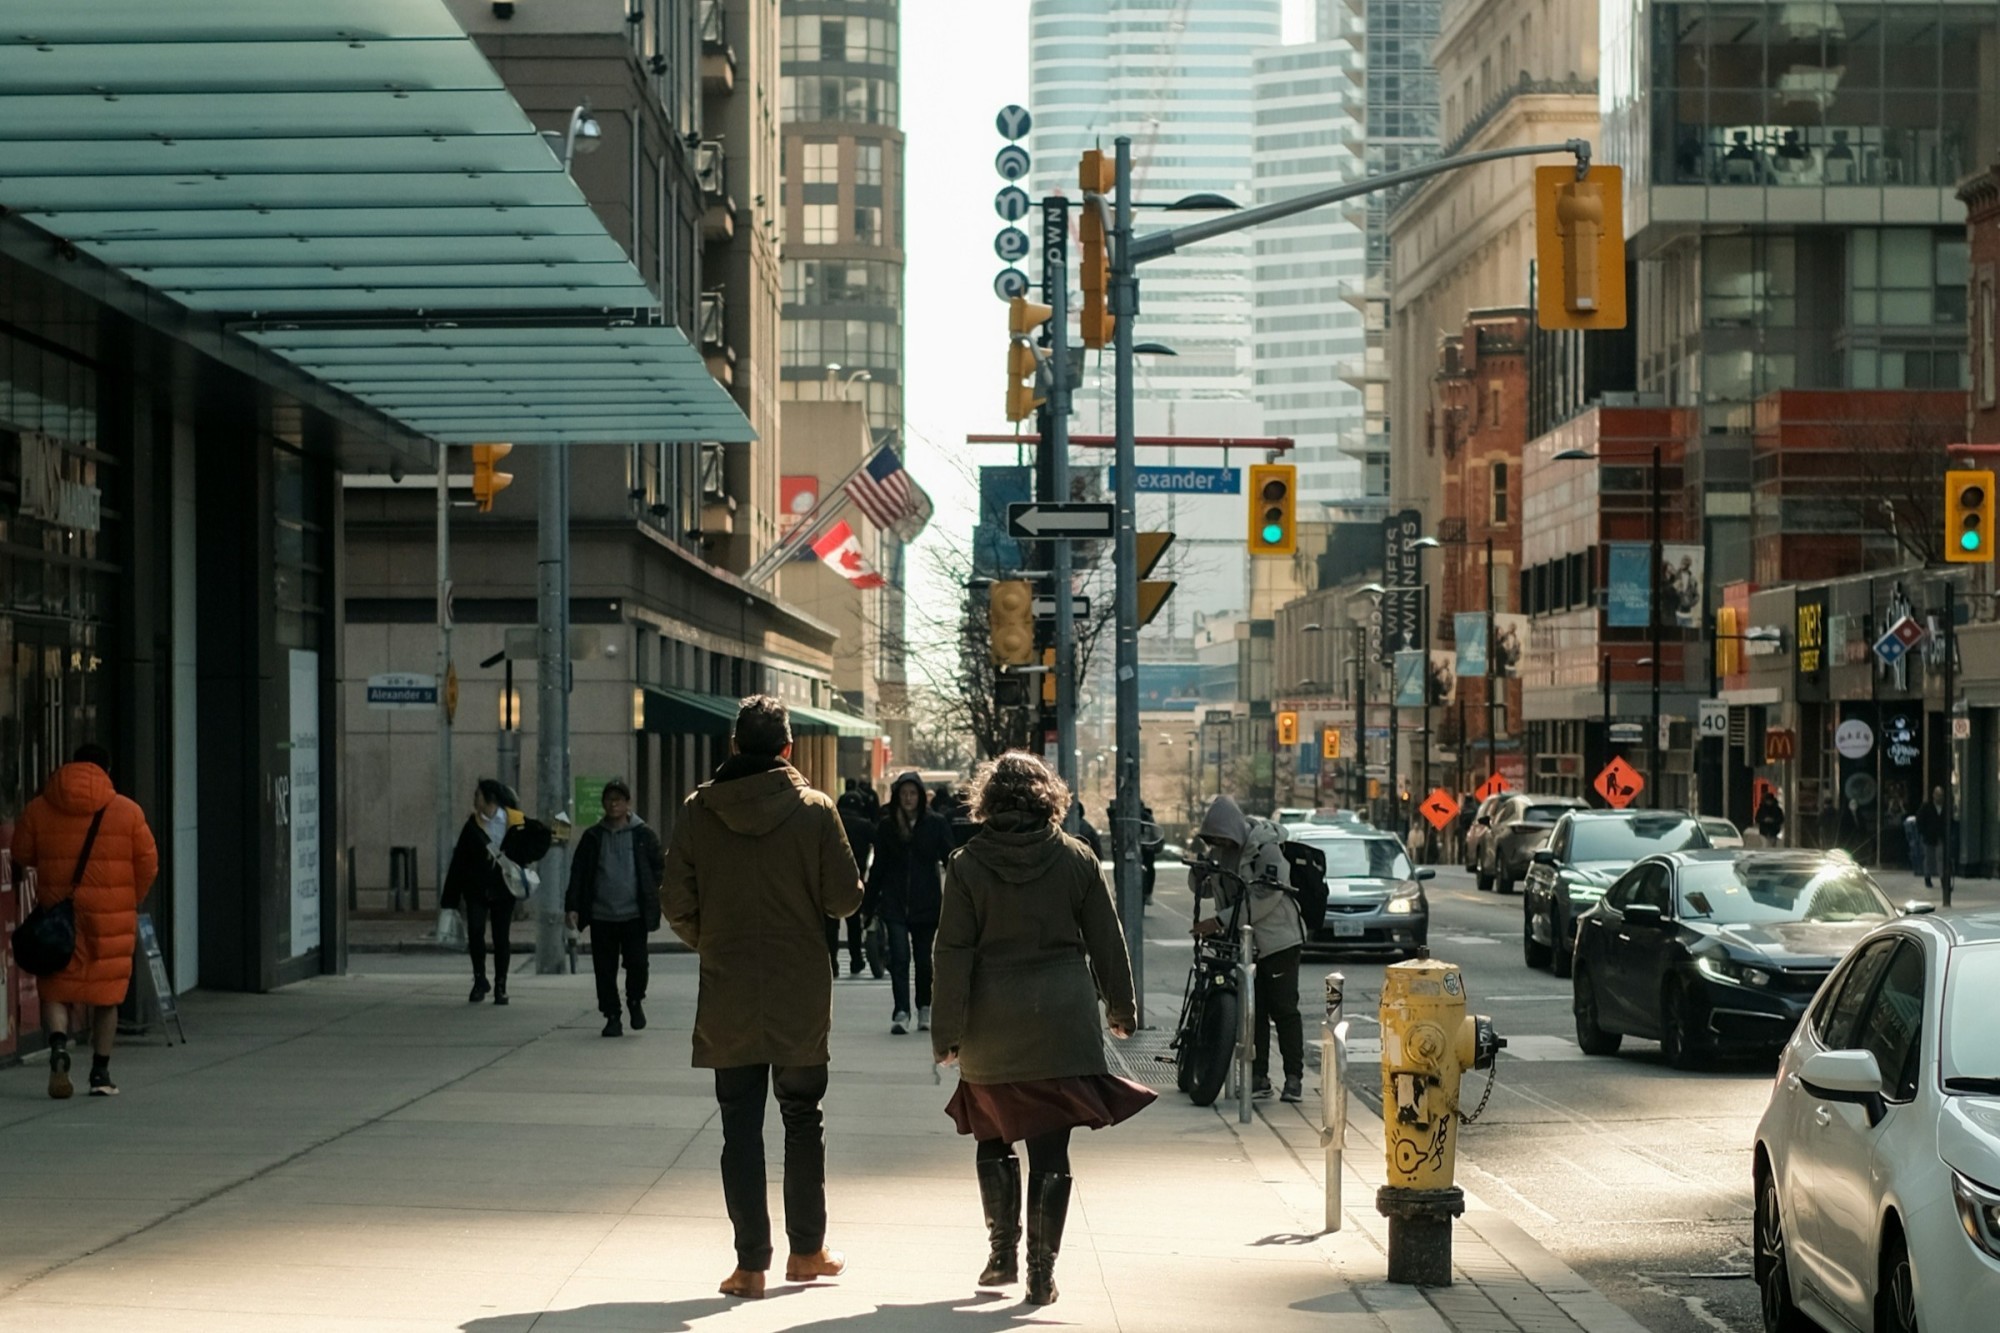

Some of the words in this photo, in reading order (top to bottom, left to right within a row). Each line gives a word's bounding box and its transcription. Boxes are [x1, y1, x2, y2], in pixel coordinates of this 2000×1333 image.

[1134, 471, 1215, 489] exander
[1403, 522, 1416, 632] WINNERS
[371, 688, 421, 700] Alexander
[1702, 714, 1726, 730] 40
